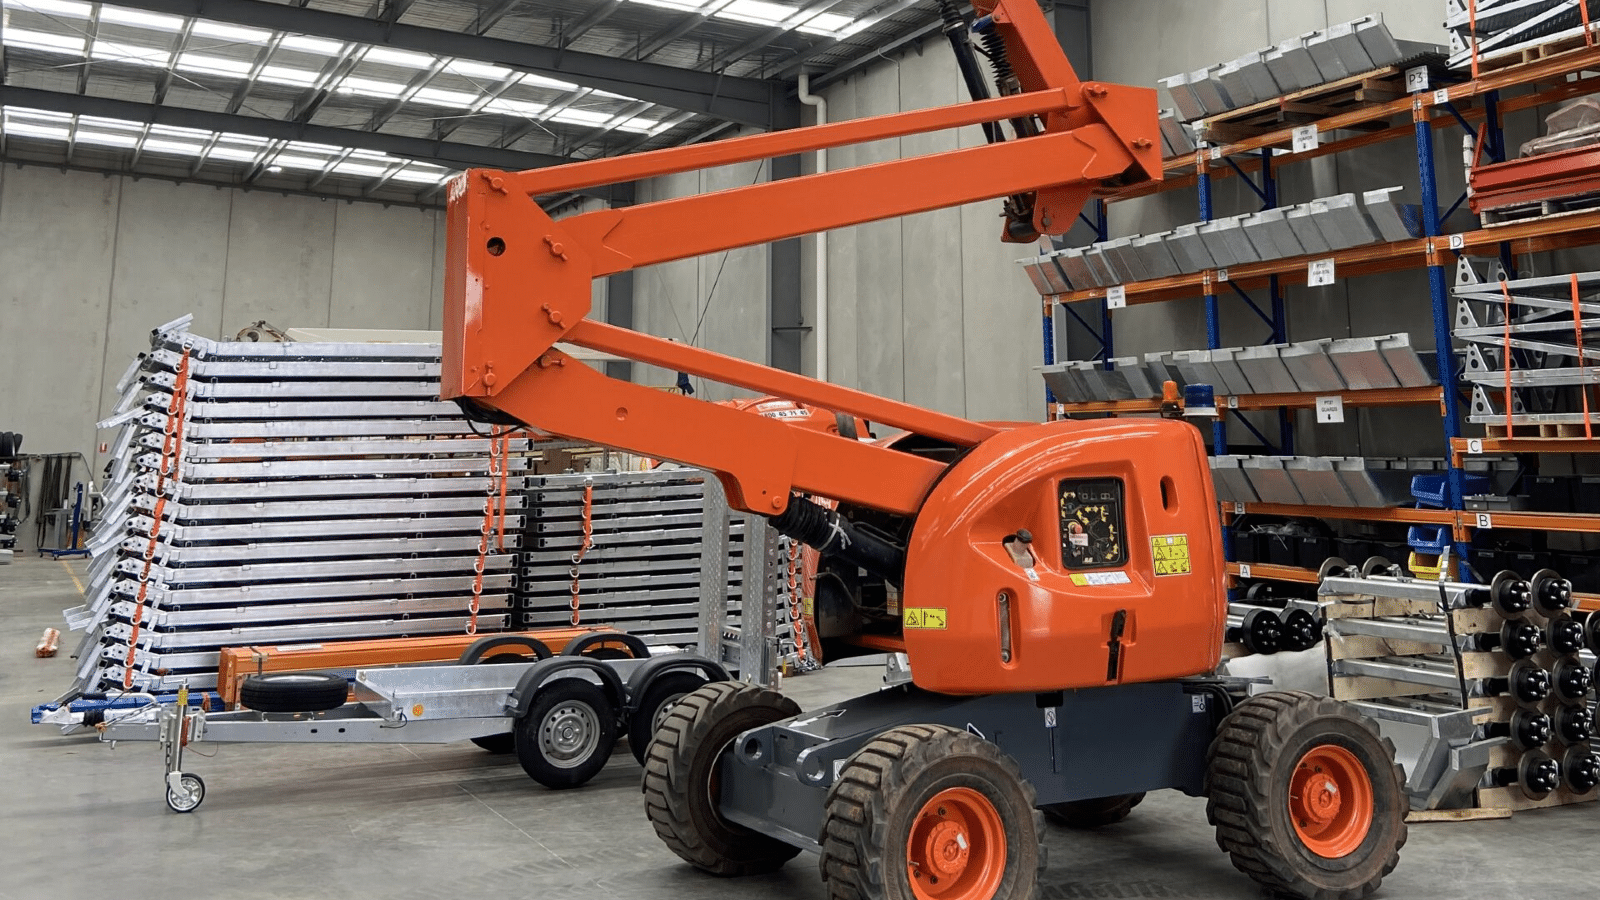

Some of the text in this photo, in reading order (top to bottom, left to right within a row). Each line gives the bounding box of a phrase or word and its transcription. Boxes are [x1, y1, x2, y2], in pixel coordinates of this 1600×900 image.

[1409, 72, 1424, 86] P3
[1452, 235, 1462, 247] D
[1219, 270, 1227, 280] D
[1230, 396, 1237, 407] C
[1470, 440, 1479, 452] C
[1236, 502, 1244, 512] B
[1479, 514, 1489, 526] B
[1241, 565, 1250, 576] A
